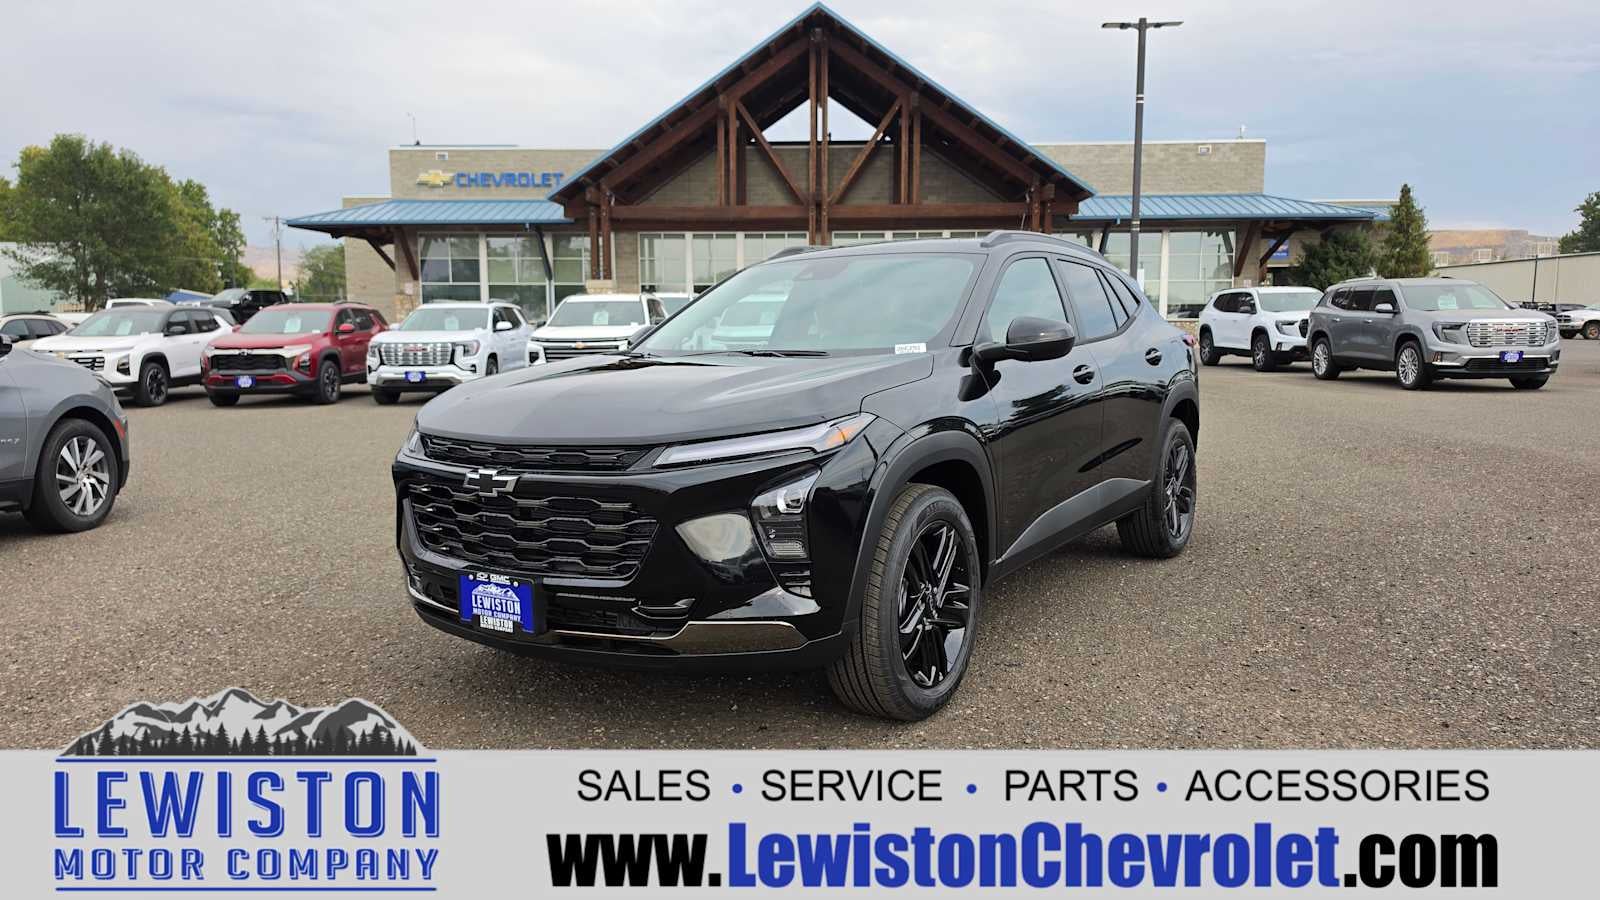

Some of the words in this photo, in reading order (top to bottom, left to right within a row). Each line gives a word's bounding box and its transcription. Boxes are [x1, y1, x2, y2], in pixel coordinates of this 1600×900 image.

[455, 172, 564, 188] CHEVROLET
[472, 594, 521, 615] LEWISTON
[472, 608, 492, 616] MOTOR
[493, 611, 521, 621] COMPANY
[480, 615, 513, 629] LEWISTON
